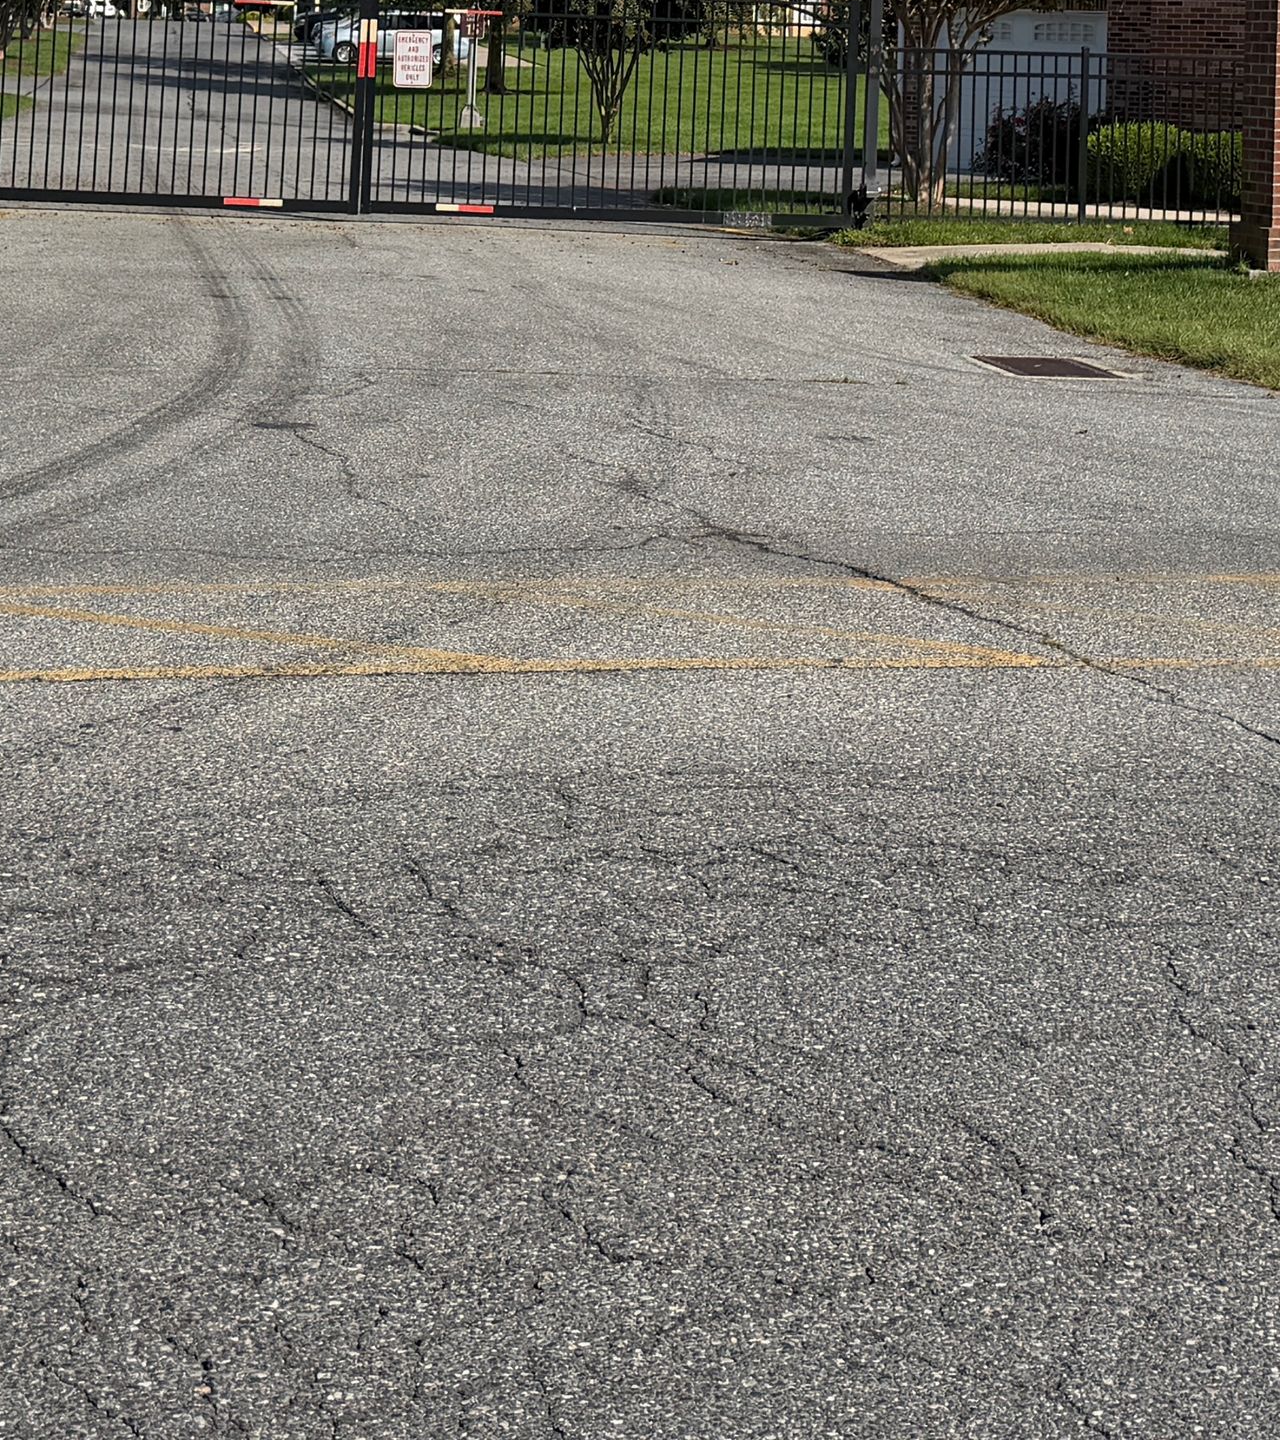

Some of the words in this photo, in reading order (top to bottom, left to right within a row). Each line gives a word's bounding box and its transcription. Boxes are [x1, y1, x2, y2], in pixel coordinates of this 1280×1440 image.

[398, 36, 429, 44] EMERGENCY
[408, 45, 420, 53] AND
[401, 64, 425, 72] VEHICLES
[405, 73, 419, 81] ONLY
